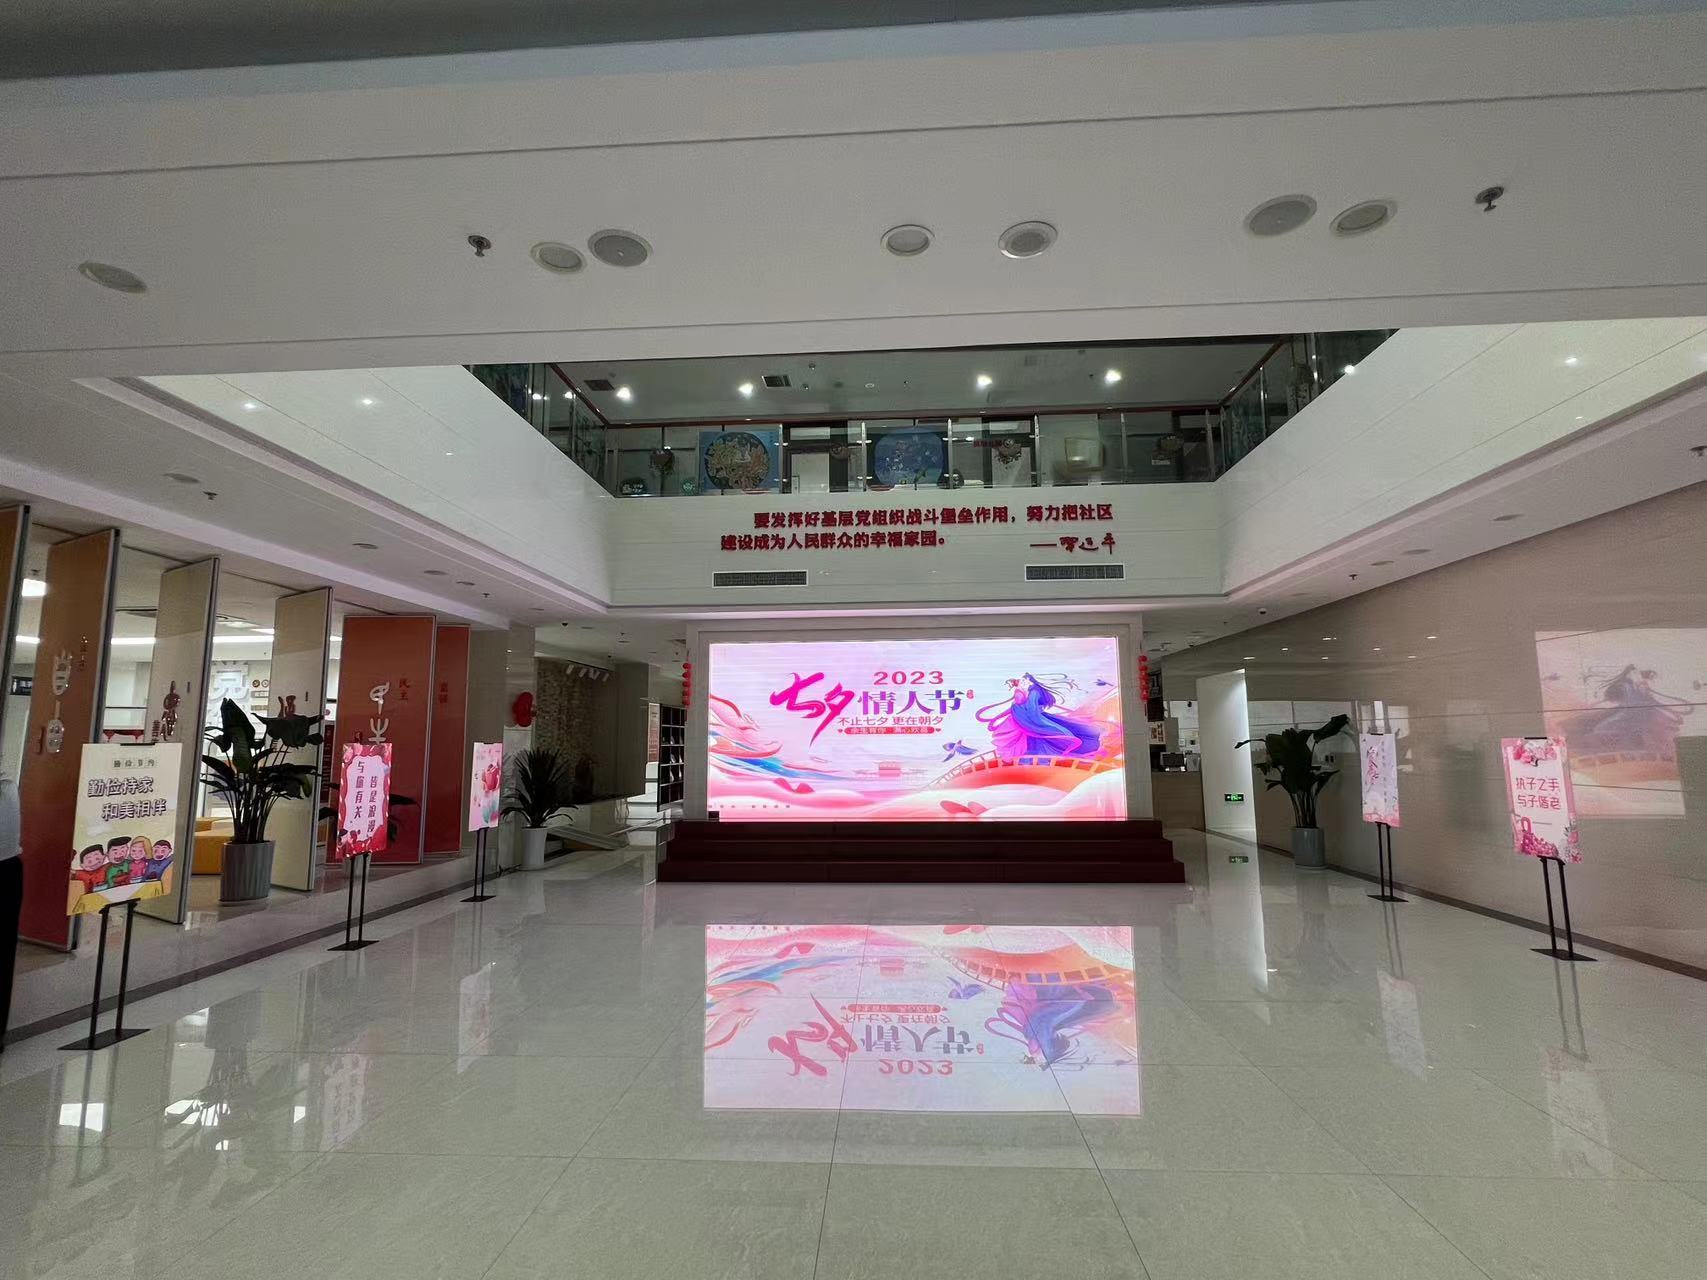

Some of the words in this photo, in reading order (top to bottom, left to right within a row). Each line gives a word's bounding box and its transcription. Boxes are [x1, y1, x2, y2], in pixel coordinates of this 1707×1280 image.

[721, 530, 945, 551] 建设成为人民群众的幸福家园。
[873, 670, 944, 685] 2023
[769, 672, 855, 747] 七夕
[857, 689, 965, 715] 情人节
[839, 716, 889, 726] 不止七夕
[88, 776, 154, 797] 勤俭持家
[1515, 777, 1559, 792] 执子之手
[102, 798, 167, 821] 和美相伴
